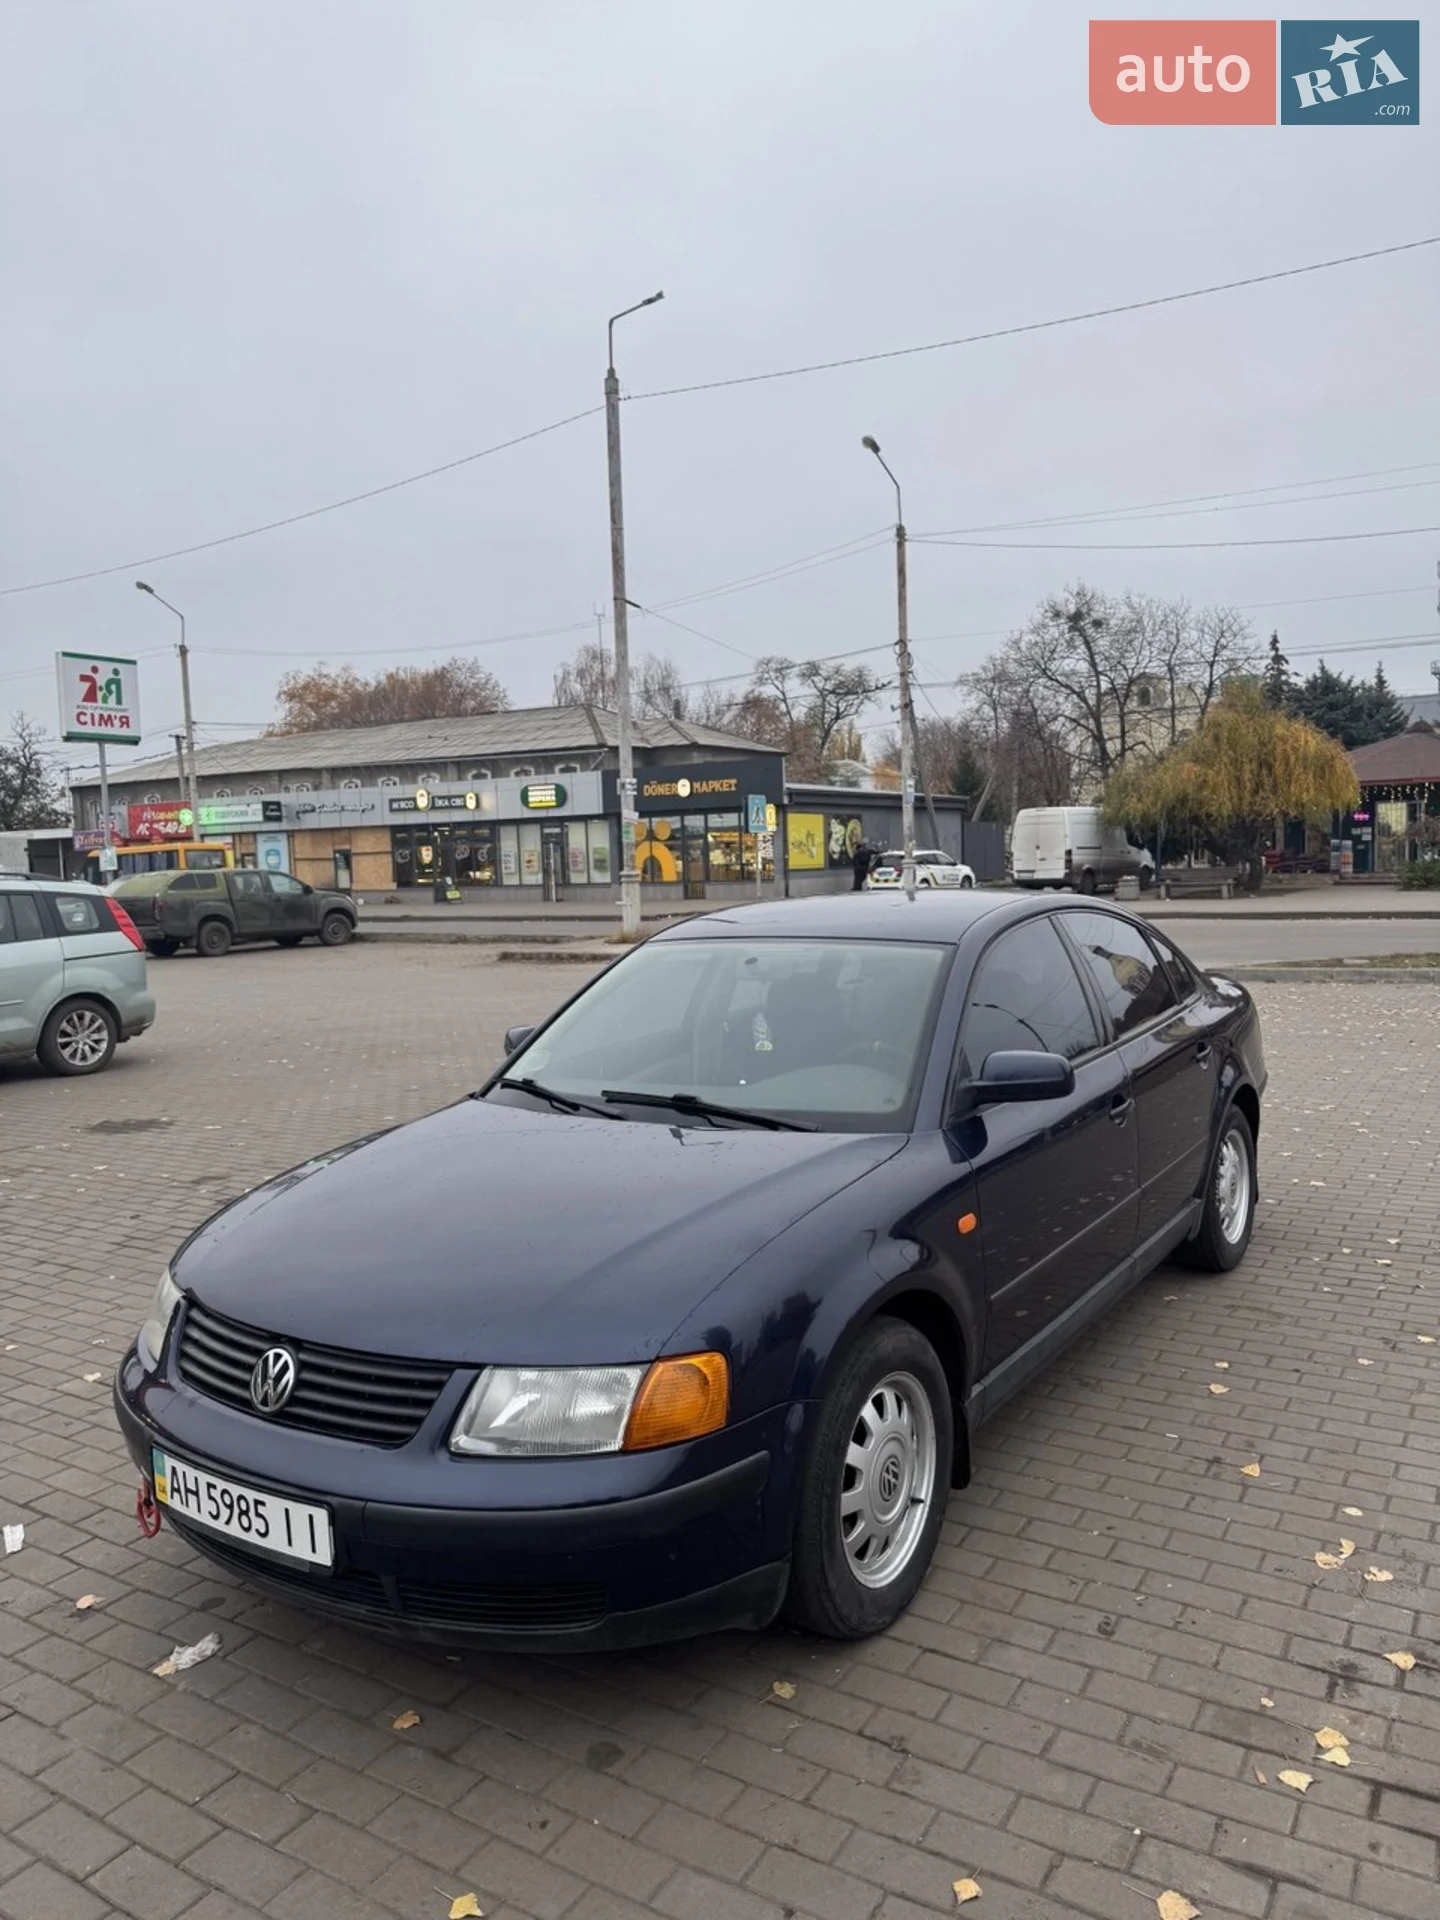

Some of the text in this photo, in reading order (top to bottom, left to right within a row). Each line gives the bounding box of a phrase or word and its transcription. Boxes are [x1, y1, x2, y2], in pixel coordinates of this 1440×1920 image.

[75, 710, 131, 729] СІМ'Я
[643, 780, 679, 797] DÖNER
[170, 1465, 202, 1514] AH
[206, 1480, 270, 1539] 5985
